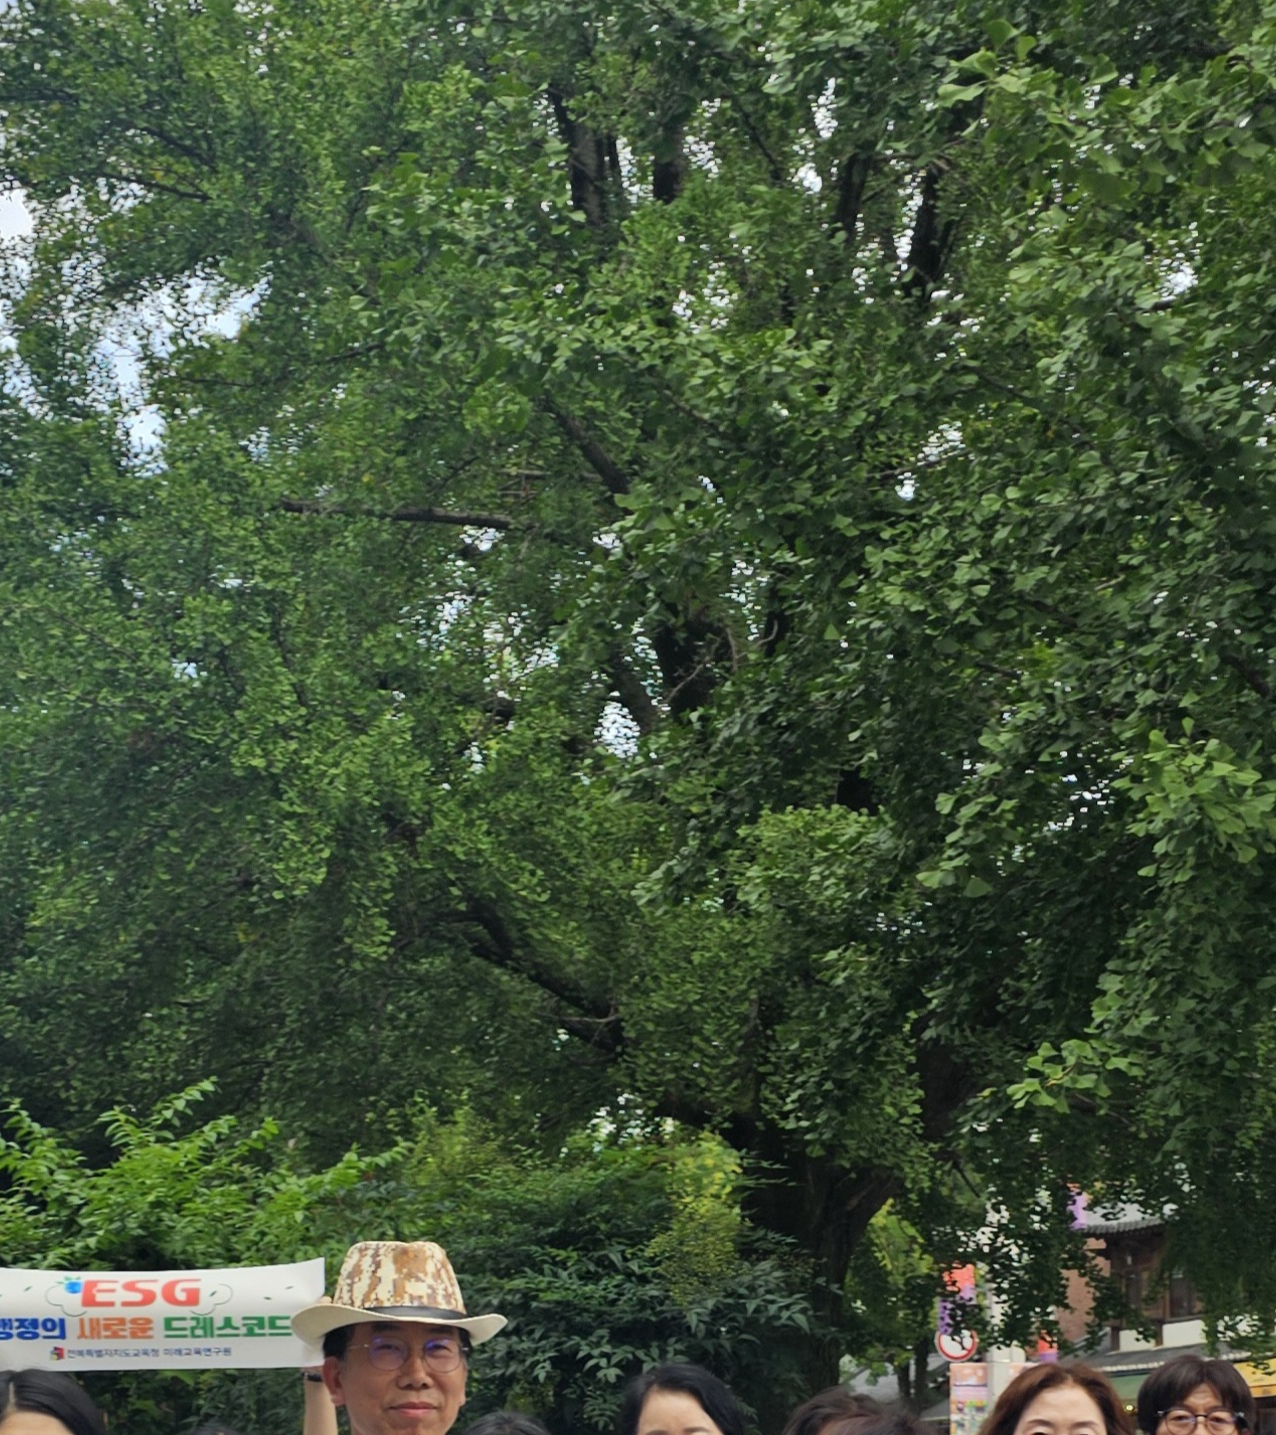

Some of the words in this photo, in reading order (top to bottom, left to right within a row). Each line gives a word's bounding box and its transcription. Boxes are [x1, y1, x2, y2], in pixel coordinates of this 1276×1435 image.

[81, 1278, 201, 1308] ESG
[79, 1317, 152, 1339] 새로운
[164, 1316, 290, 1338] 드레스코드
